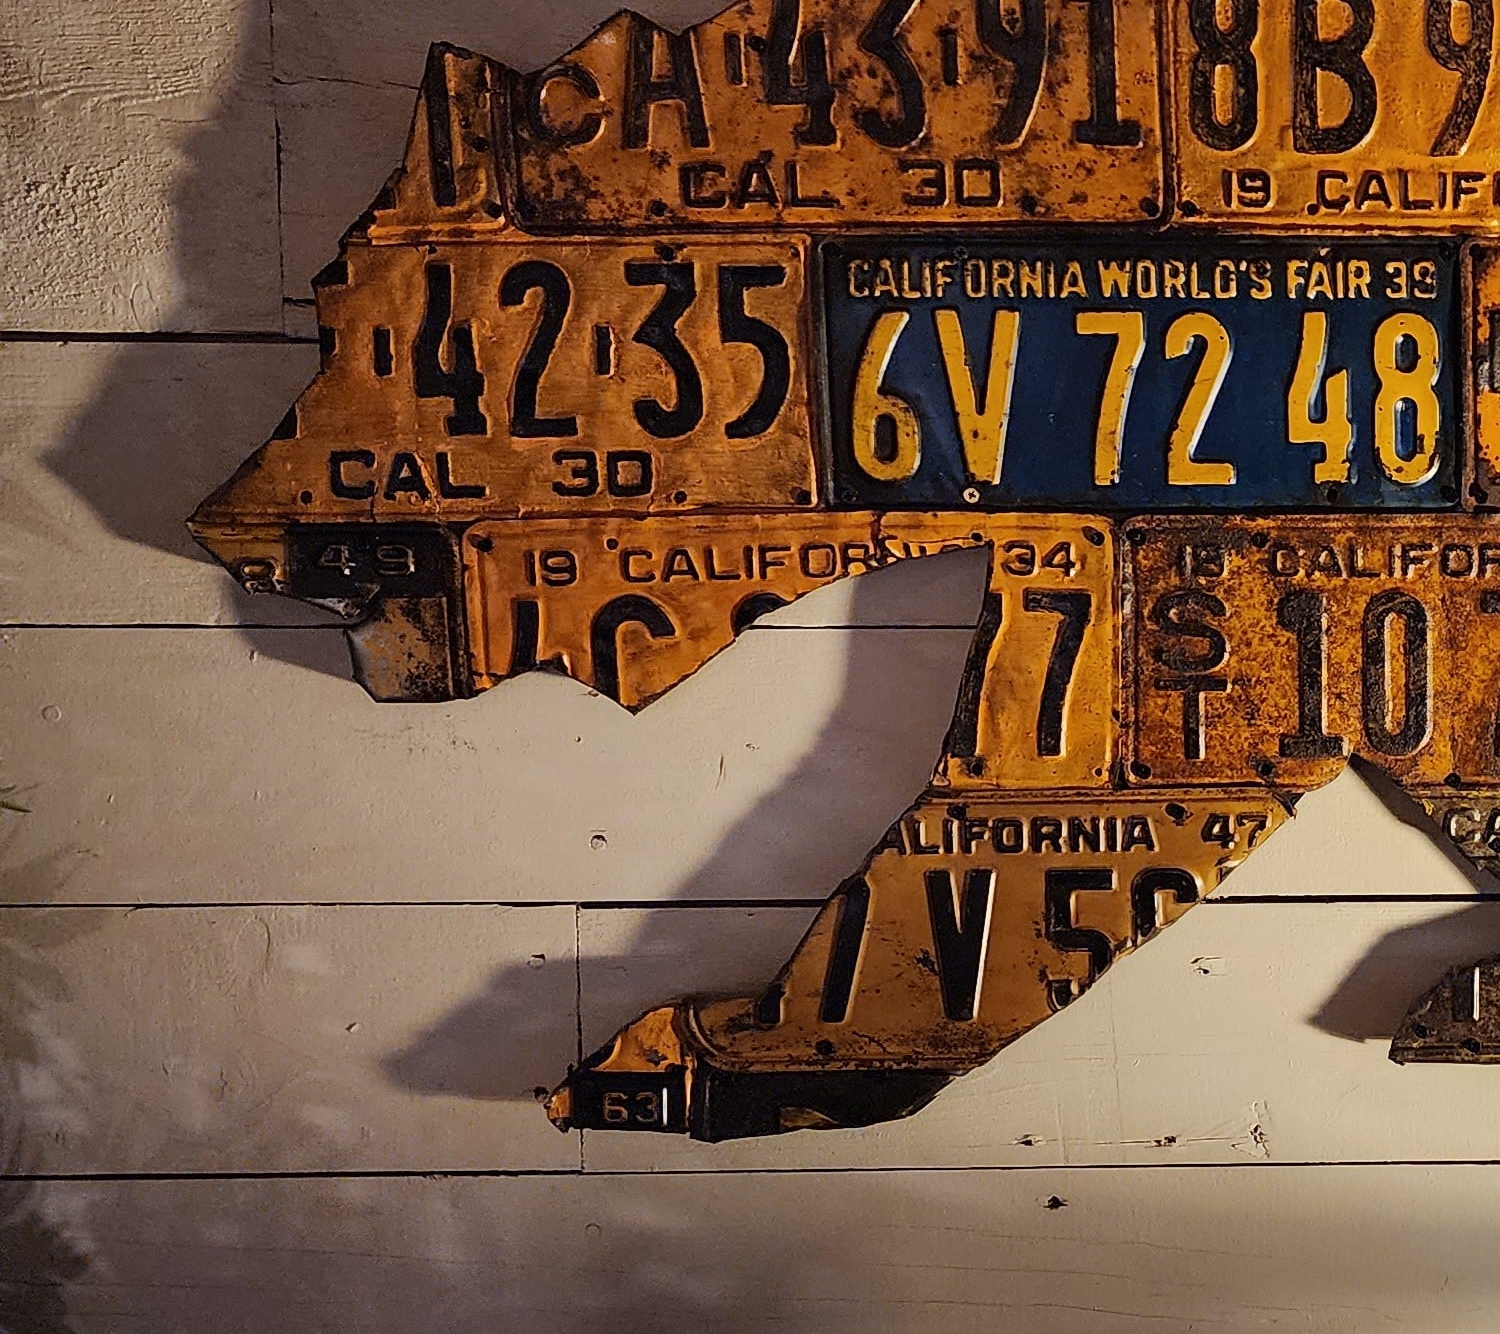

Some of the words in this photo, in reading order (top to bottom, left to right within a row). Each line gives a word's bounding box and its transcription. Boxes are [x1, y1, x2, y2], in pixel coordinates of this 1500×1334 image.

[680, 161, 841, 208] CAL
[902, 158, 1002, 207] 30
[1221, 172, 1277, 209] 19
[846, 257, 1090, 300] CALIFORNIA
[1099, 258, 1273, 300] WORLD'S
[1286, 258, 1372, 300] FAIR
[1383, 258, 1439, 300] 39
[851, 309, 1023, 486] 6V
[1074, 309, 1238, 487] 72
[1286, 309, 1444, 486] 48
[329, 450, 487, 501] CAL
[551, 449, 653, 497] 30
[524, 550, 578, 587] 19
[1001, 540, 1078, 578] 34
[600, 1089, 661, 1126] 63
